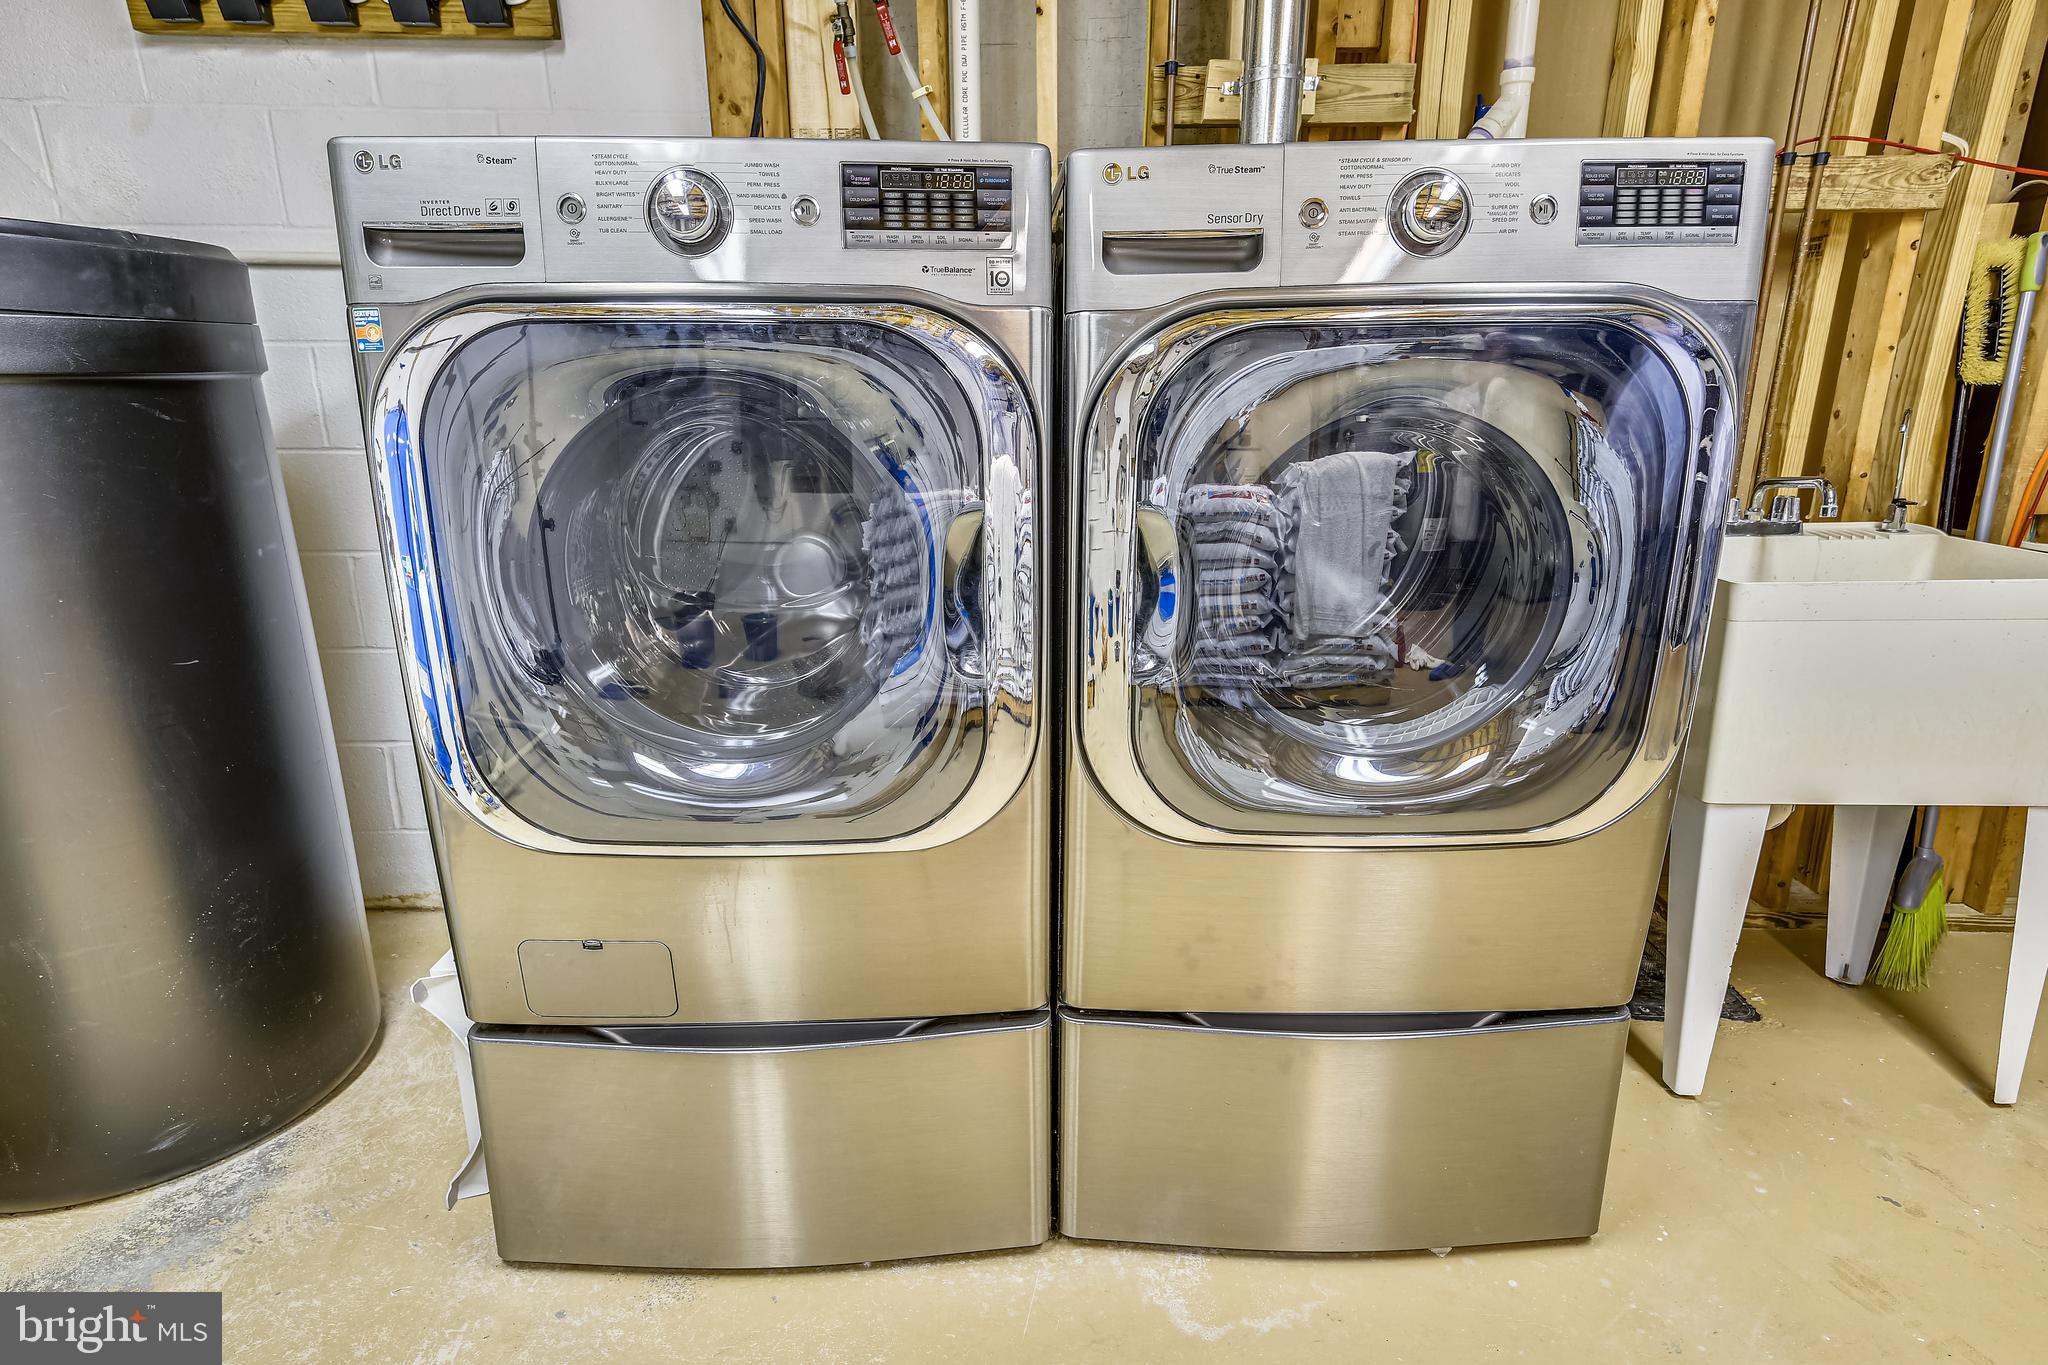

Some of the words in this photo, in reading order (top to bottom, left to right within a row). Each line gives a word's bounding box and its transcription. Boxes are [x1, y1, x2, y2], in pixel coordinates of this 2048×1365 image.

[960, 13, 968, 31] ASTM
[378, 155, 403, 170] LG
[1127, 166, 1150, 181] LG
[420, 205, 452, 217] Direct
[454, 205, 481, 217] Drive
[1207, 213, 1244, 225] Sensor
[1245, 213, 1264, 225] Dry
[989, 270, 1010, 288] 10
